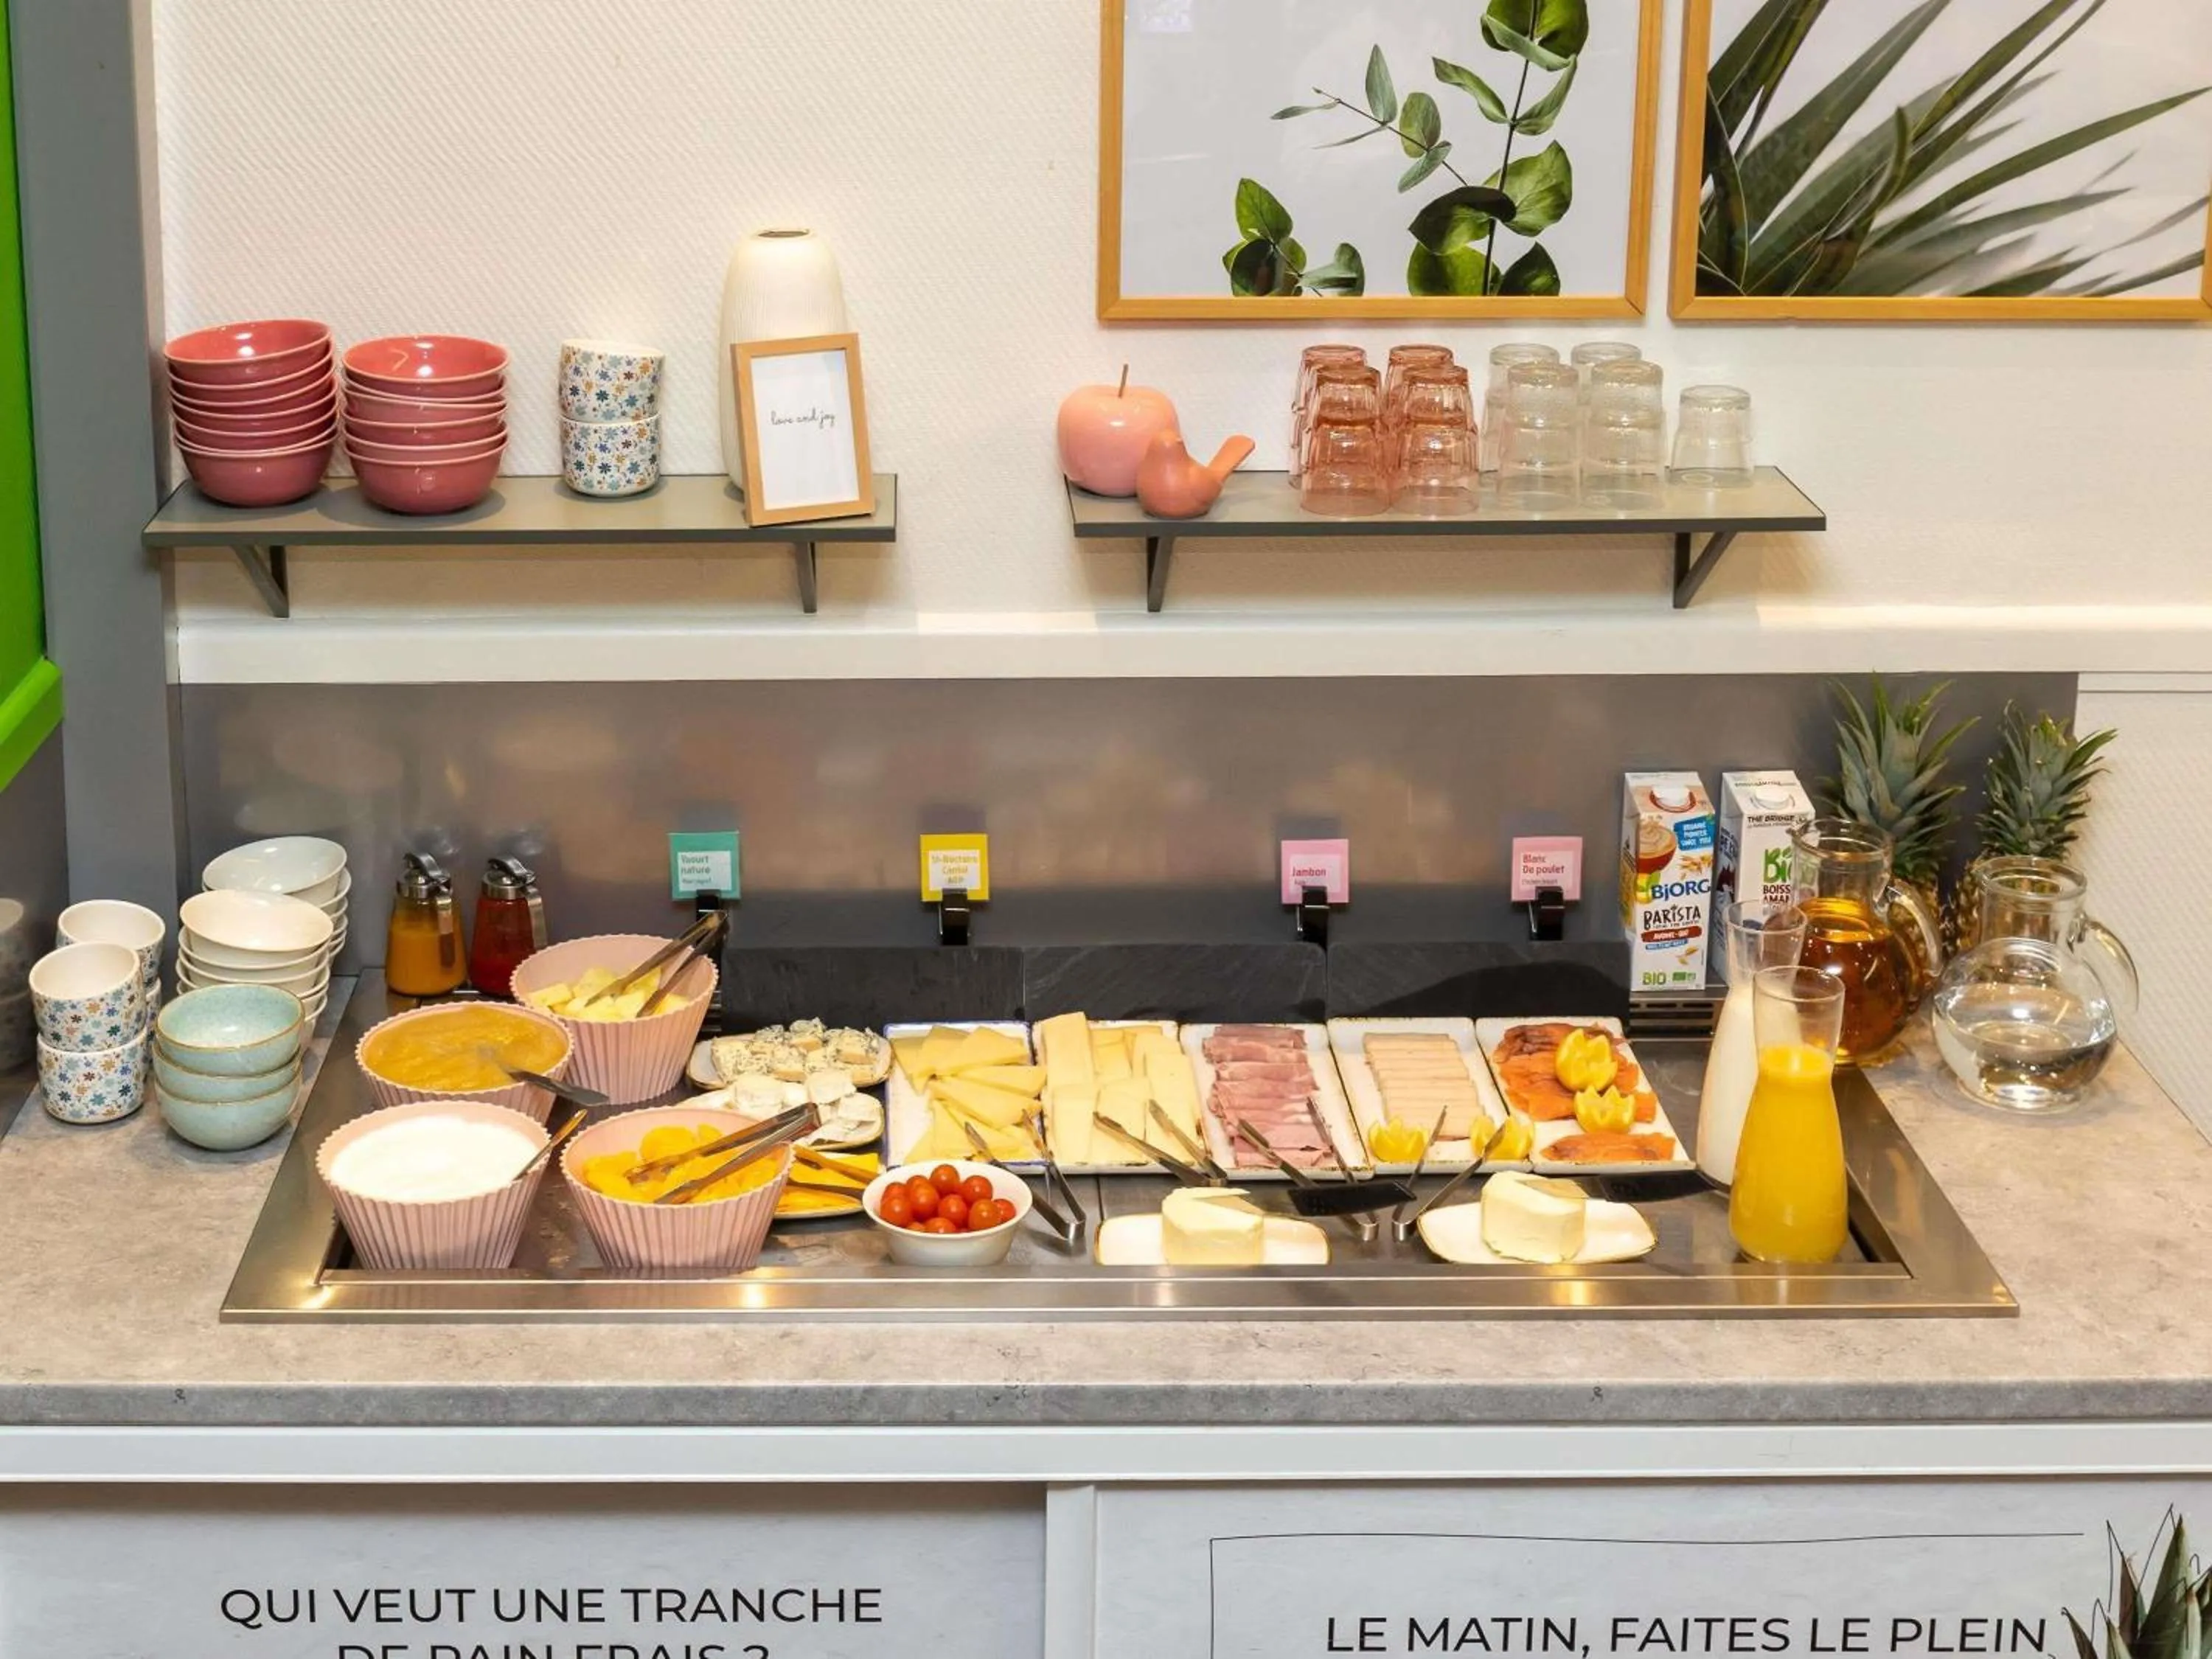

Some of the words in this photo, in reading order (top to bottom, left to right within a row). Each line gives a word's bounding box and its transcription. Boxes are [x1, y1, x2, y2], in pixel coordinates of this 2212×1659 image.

[771, 410, 793, 425] love
[796, 408, 818, 422] and
[818, 409, 835, 430] joy
[1764, 814, 1795, 822] BRIDGE
[1292, 866, 1327, 877] Jambon
[1536, 864, 1565, 876] poulet
[1763, 884, 1791, 894] BOISS
[1641, 971, 1666, 986] BIO
[220, 1588, 316, 1630] QUI
[333, 1588, 476, 1623] VEUT
[493, 1588, 605, 1623] UNE
[620, 1588, 882, 1623] TRANCHE
[1327, 1617, 1387, 1652] LE
[1408, 1617, 1590, 1658] MATIN,
[1610, 1617, 1790, 1652] FAITES
[1810, 1618, 1871, 1652] LE
[1890, 1618, 2046, 1652] PLEIN
